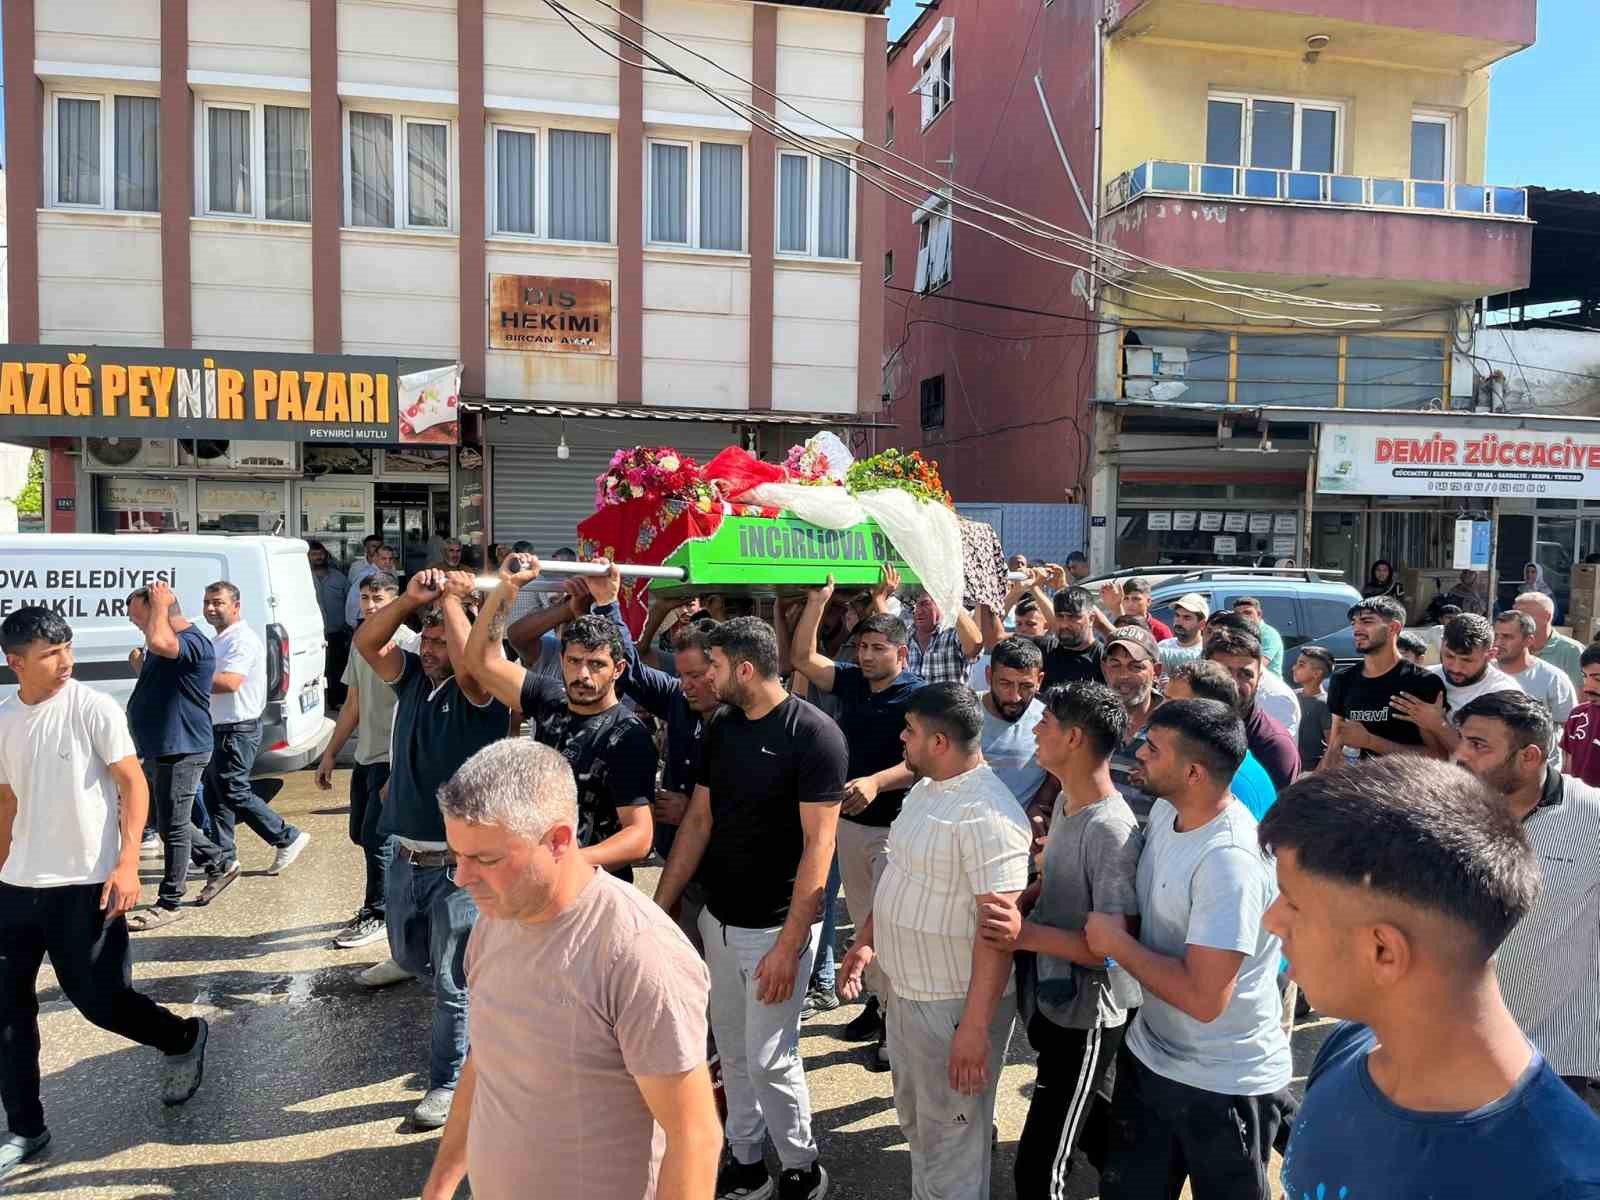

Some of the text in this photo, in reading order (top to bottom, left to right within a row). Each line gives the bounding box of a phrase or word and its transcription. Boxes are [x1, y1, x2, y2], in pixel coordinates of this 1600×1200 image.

[0, 352, 390, 424] AZIĞ PEYNİR PAZARI
[356, 429, 388, 440] MUTLU
[1375, 432, 1600, 471] DEMİR ZÜCCACİYE
[46, 567, 176, 589] BELEDİYESİ
[95, 599, 129, 617] AR
